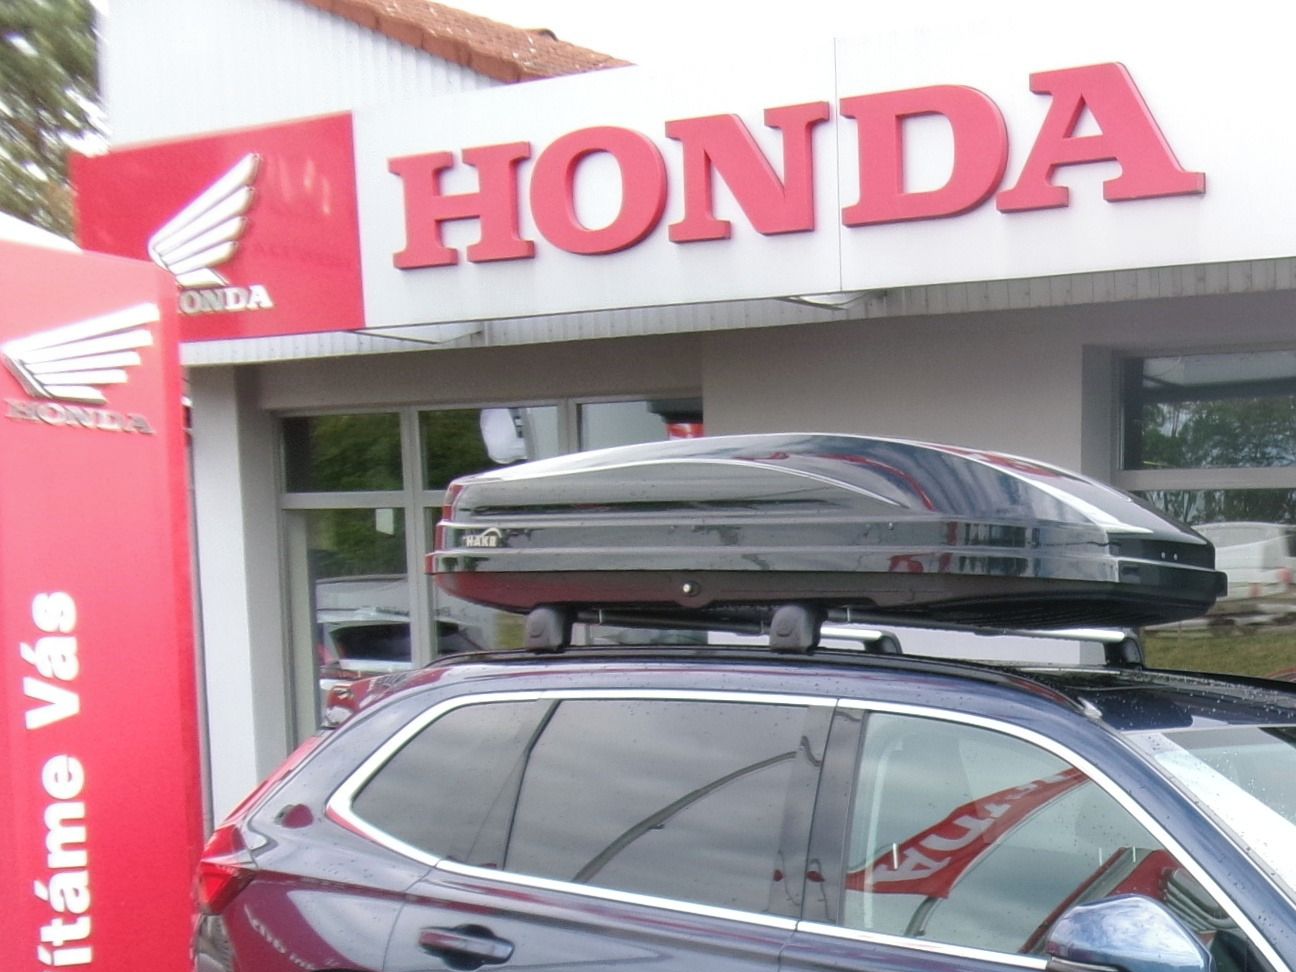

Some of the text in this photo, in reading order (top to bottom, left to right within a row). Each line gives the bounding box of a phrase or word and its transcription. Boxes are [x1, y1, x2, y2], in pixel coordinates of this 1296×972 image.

[387, 61, 1206, 270] HONDA
[177, 284, 274, 314] ONDA
[4, 400, 155, 435] HONDA
[19, 591, 81, 730] Vás
